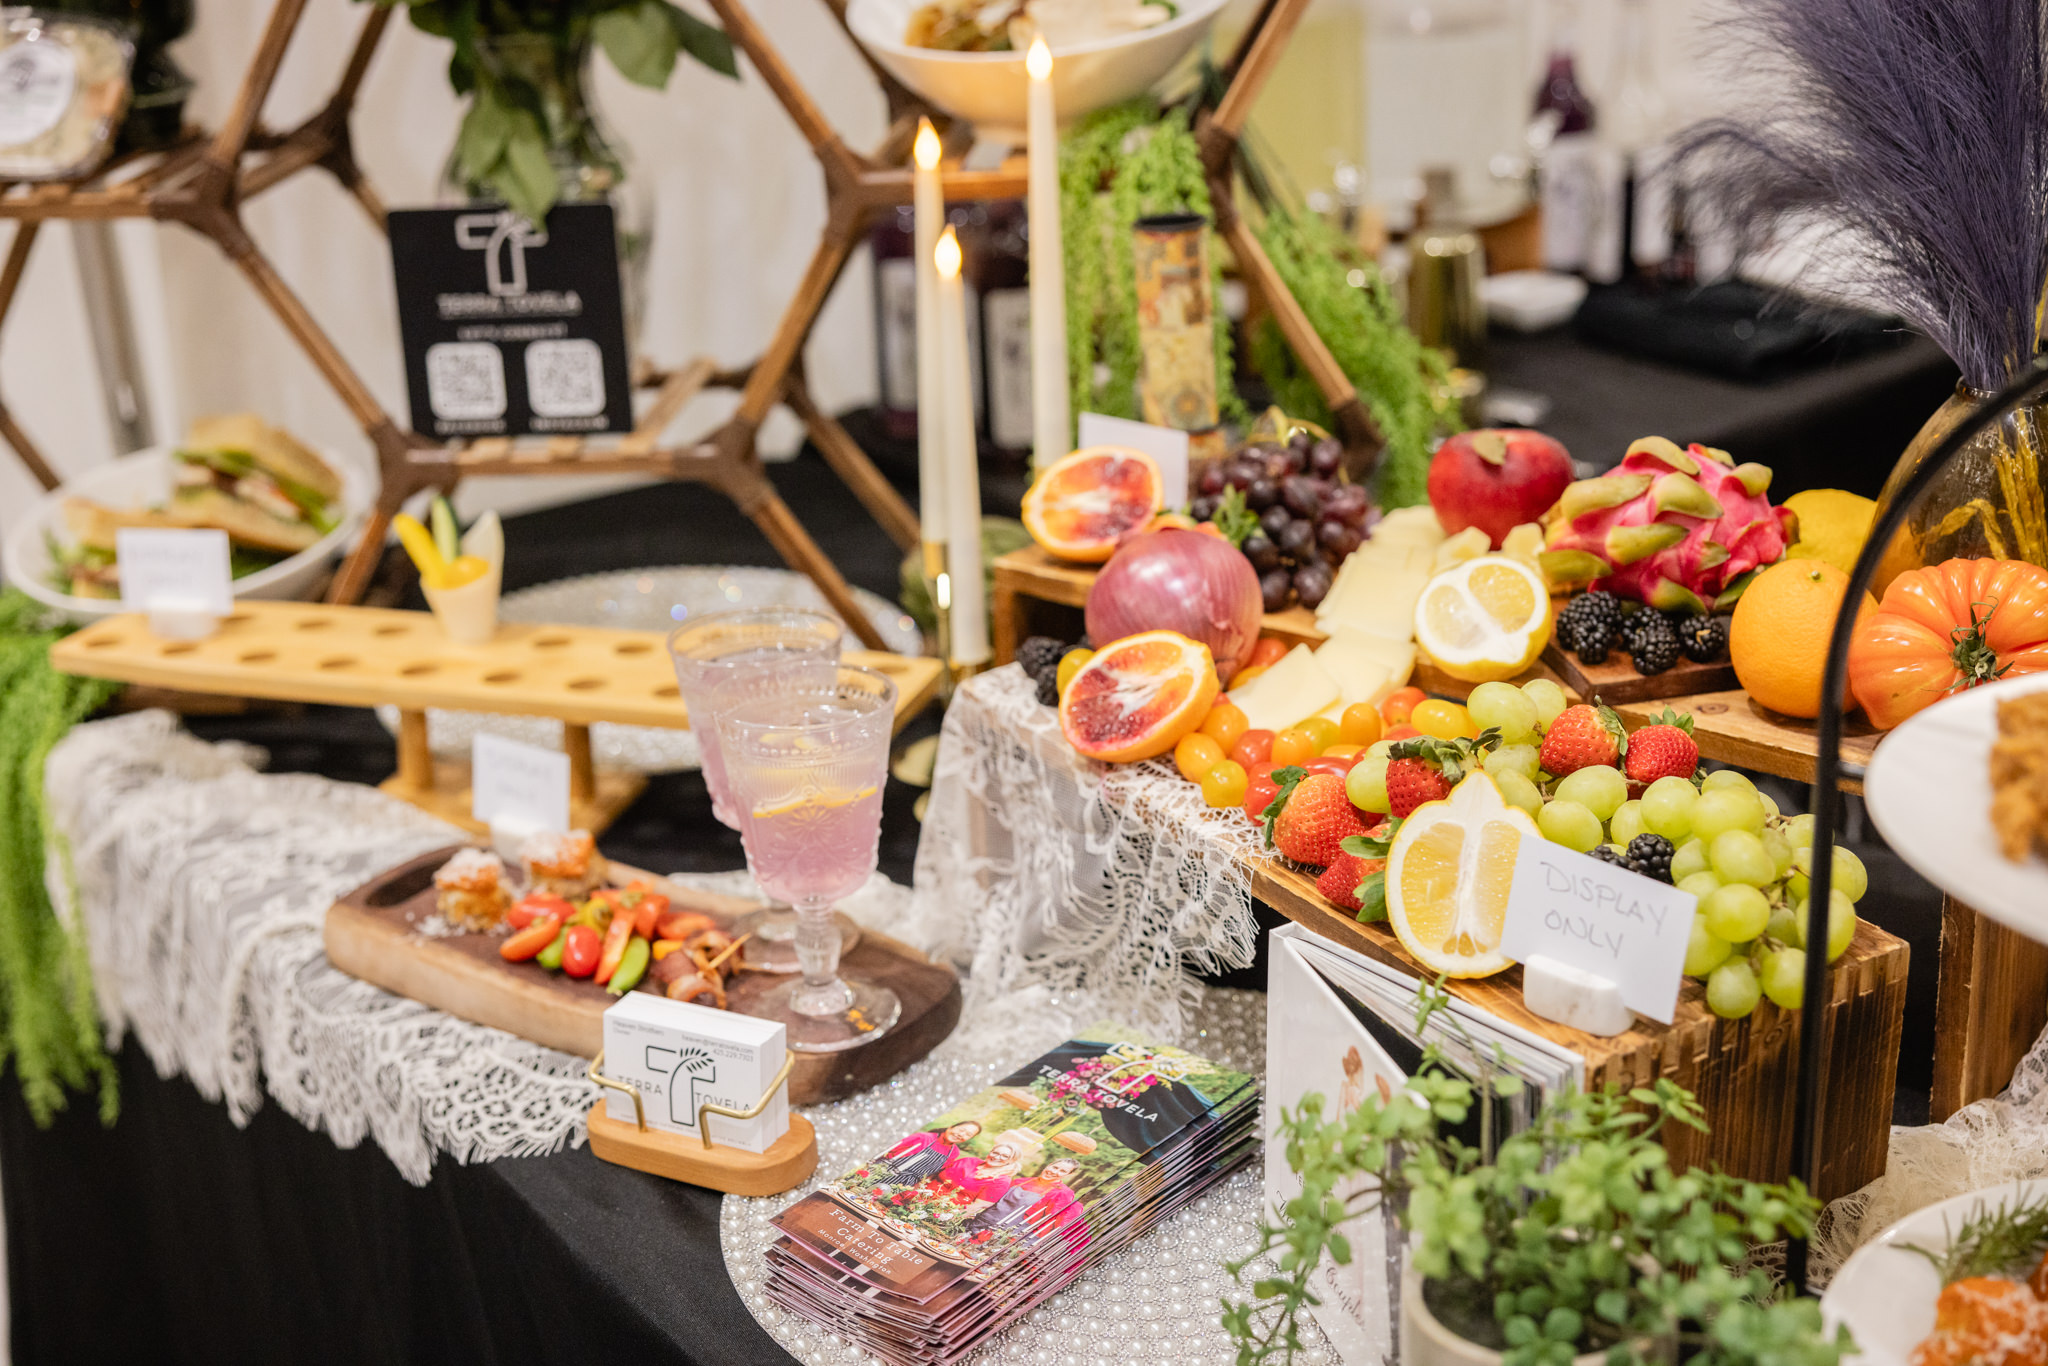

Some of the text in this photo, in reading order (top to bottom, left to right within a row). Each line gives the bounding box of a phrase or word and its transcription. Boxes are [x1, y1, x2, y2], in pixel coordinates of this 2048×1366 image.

[1540, 861, 1668, 936] DISPLAY
[1544, 909, 1624, 959] ONLY
[1038, 1064, 1159, 1122] TERRA TOVELA
[829, 1208, 923, 1265] Farm To Table
[837, 1227, 894, 1265] Catering
[849, 1247, 892, 1275] Washington
